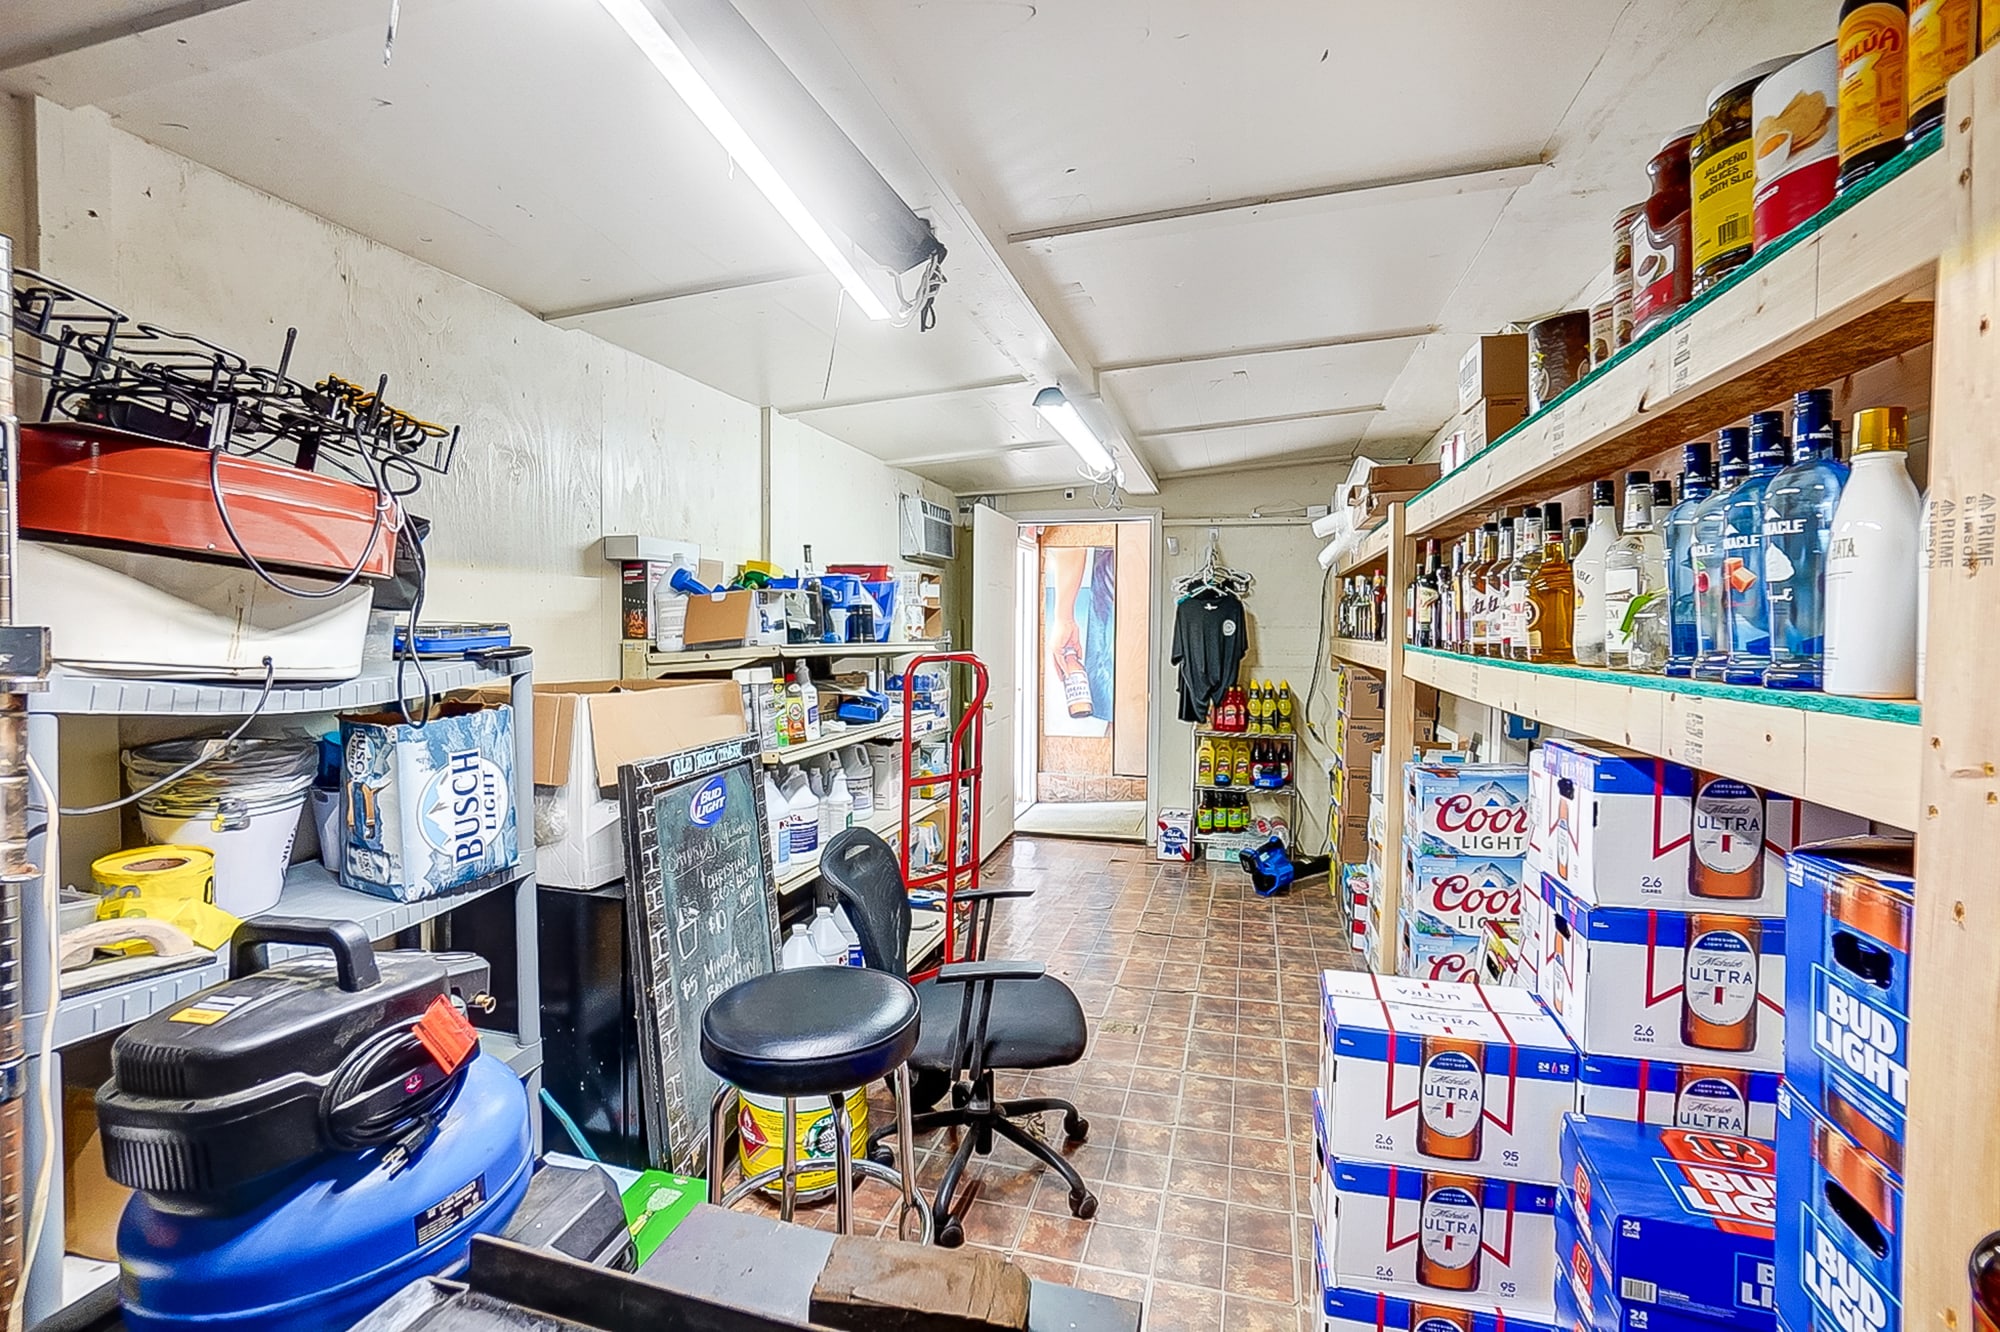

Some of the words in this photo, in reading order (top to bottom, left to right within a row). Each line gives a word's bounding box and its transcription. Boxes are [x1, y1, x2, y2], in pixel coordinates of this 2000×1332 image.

[453, 750, 485, 863] BUSCH
[483, 774, 497, 830] LIGHT
[696, 796, 726, 818] LIGHT
[1435, 794, 1528, 834] Coor
[1698, 815, 1760, 831] ULTRA
[1462, 835, 1523, 851] LIGHT
[1641, 876, 1663, 889] 2.6
[1432, 875, 1521, 915] Coor
[1690, 966, 1753, 985] ULTRA
[1411, 1013, 1481, 1027] ULTRA
[1828, 982, 1898, 1056] BUD
[1634, 1024, 1655, 1037] 2.6
[1816, 1010, 1910, 1107] LIGHT
[1424, 1083, 1480, 1102] ULTRA
[1680, 1111, 1743, 1131] ULTRA
[1375, 1133, 1394, 1146] 2.6
[1502, 1150, 1519, 1162] 95
[1688, 1167, 1776, 1199] BU
[1535, 1196, 1547, 1206] 24
[1680, 1185, 1776, 1221] LIG
[1424, 1217, 1479, 1235] ULTRA
[1622, 1220, 1641, 1232] 24
[1376, 1265, 1394, 1277] 2.6
[1816, 1229, 1887, 1329] BUD
[1500, 1282, 1516, 1293] 95
[1629, 1309, 1648, 1322] 24
